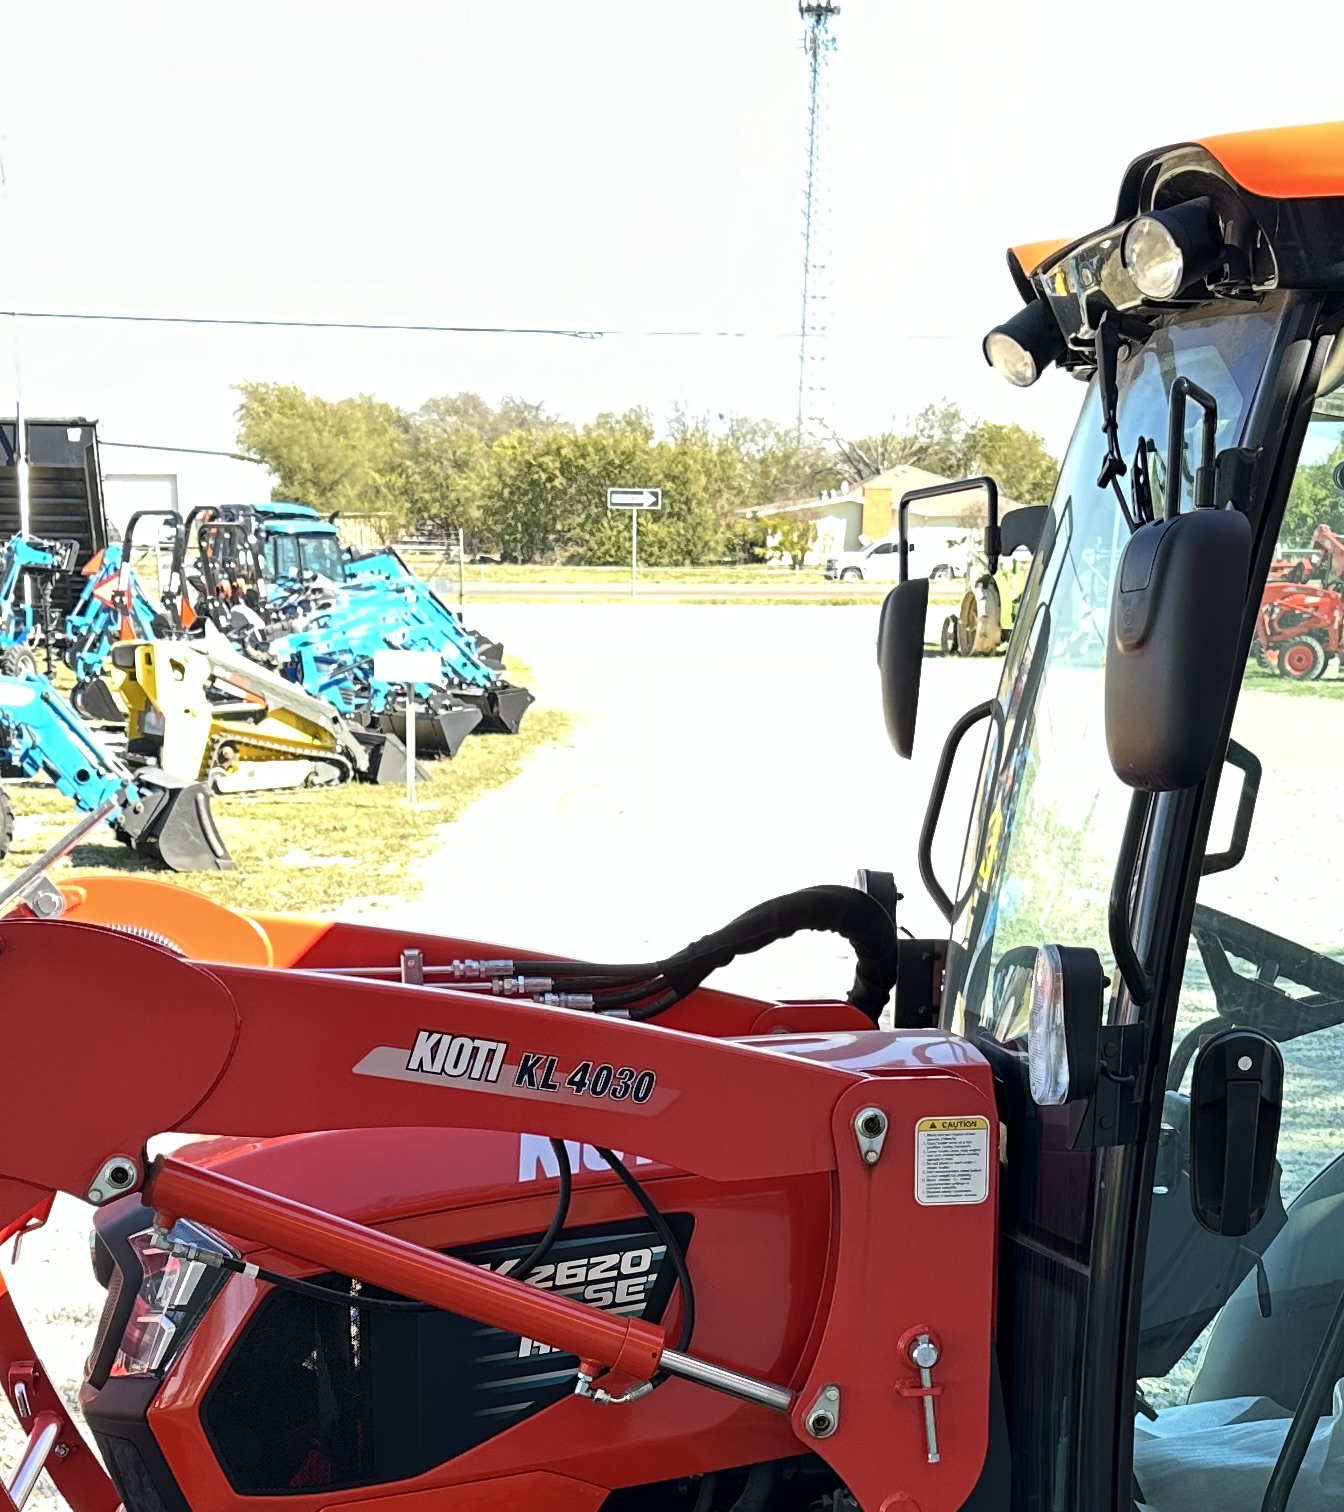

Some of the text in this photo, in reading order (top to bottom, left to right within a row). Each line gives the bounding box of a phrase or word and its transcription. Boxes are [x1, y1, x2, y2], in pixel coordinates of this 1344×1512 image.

[406, 1028, 657, 1104] KIOTI KL 4030
[941, 1120, 977, 1129] CAUTION
[584, 1275, 647, 1307] SE
